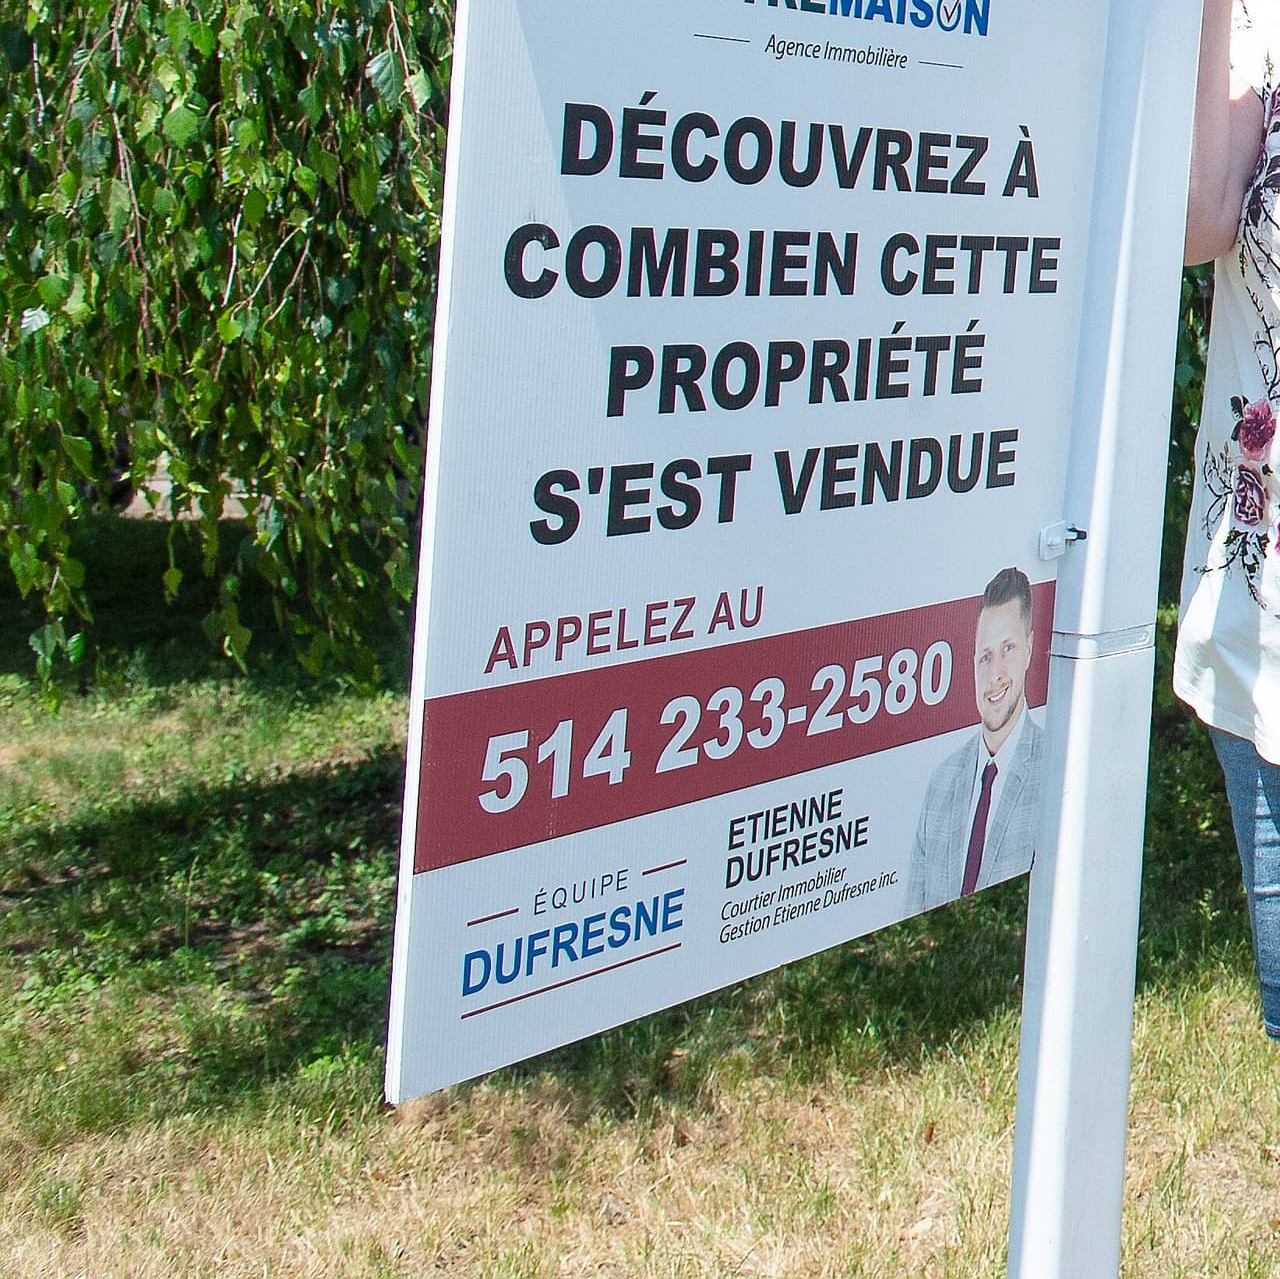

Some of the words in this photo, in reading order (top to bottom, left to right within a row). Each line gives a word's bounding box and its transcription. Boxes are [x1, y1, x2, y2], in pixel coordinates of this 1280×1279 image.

[765, 33, 821, 60] Agence
[824, 40, 908, 69] Immobilière
[560, 91, 989, 196] DÉCOUVREZ
[1002, 125, 1040, 198] À
[503, 222, 859, 299] COMBIEN
[880, 233, 1062, 295] CETTE
[606, 319, 986, 418] PROPRIÉTÉ
[529, 453, 752, 546] S'EST
[774, 428, 1019, 516] VENDUE
[484, 596, 696, 674] APPELEZ
[707, 586, 764, 634] AU
[478, 707, 632, 814] 514
[655, 639, 953, 773] 233-2580
[725, 816, 870, 889] DUFRESNE
[728, 788, 844, 851] ETIENNE
[534, 869, 629, 915] ÉQUIPE
[719, 915, 770, 944] Gestion
[773, 896, 821, 926] Etienne
[823, 882, 876, 909] Dufresne
[878, 870, 899, 889] inc.
[721, 890, 777, 920] Courtier
[778, 867, 847, 902] Immobilier
[462, 888, 685, 997] DUFRESNE
